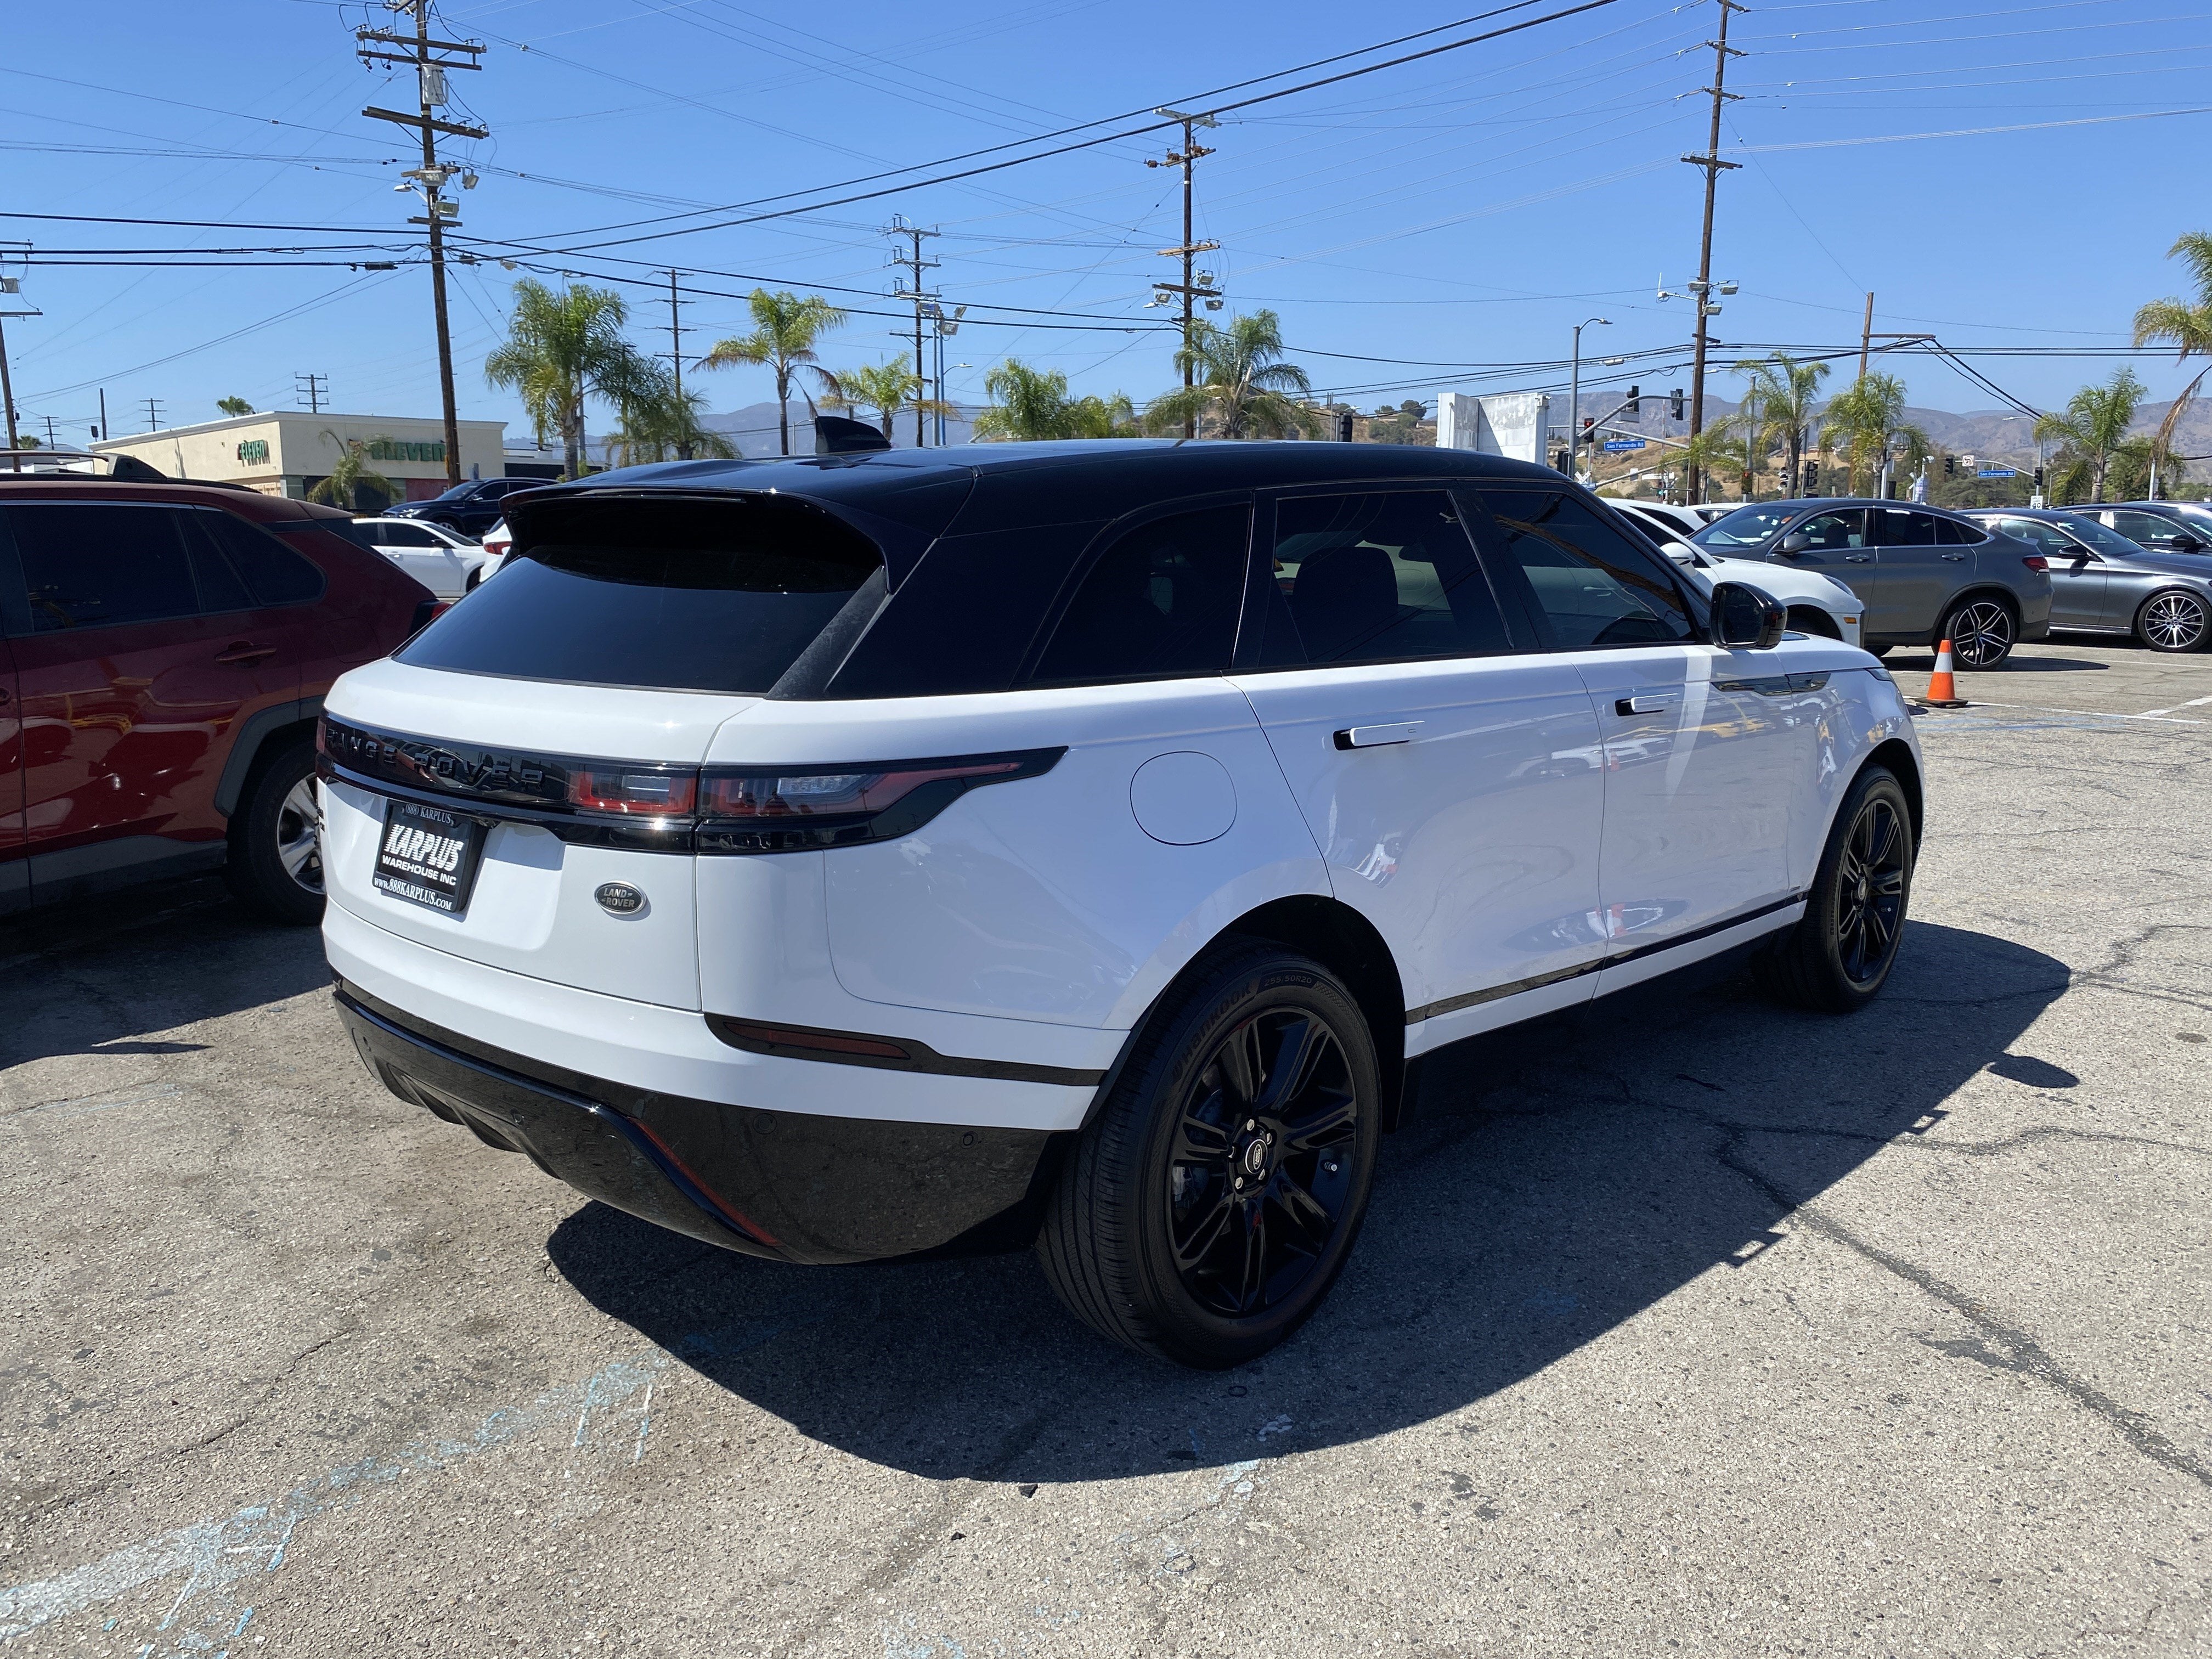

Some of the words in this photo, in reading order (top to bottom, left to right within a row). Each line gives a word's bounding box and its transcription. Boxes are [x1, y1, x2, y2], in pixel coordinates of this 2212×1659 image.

[327, 728, 397, 765] RANGE
[415, 752, 543, 791] ROVER
[405, 803, 420, 816] (888)
[420, 808, 452, 824] KARPLUS
[383, 823, 464, 872] KARPLUS
[382, 855, 439, 880] WAREHOUSE
[439, 873, 457, 886] INC
[603, 888, 627, 898] LAND
[606, 897, 635, 908] ROVER
